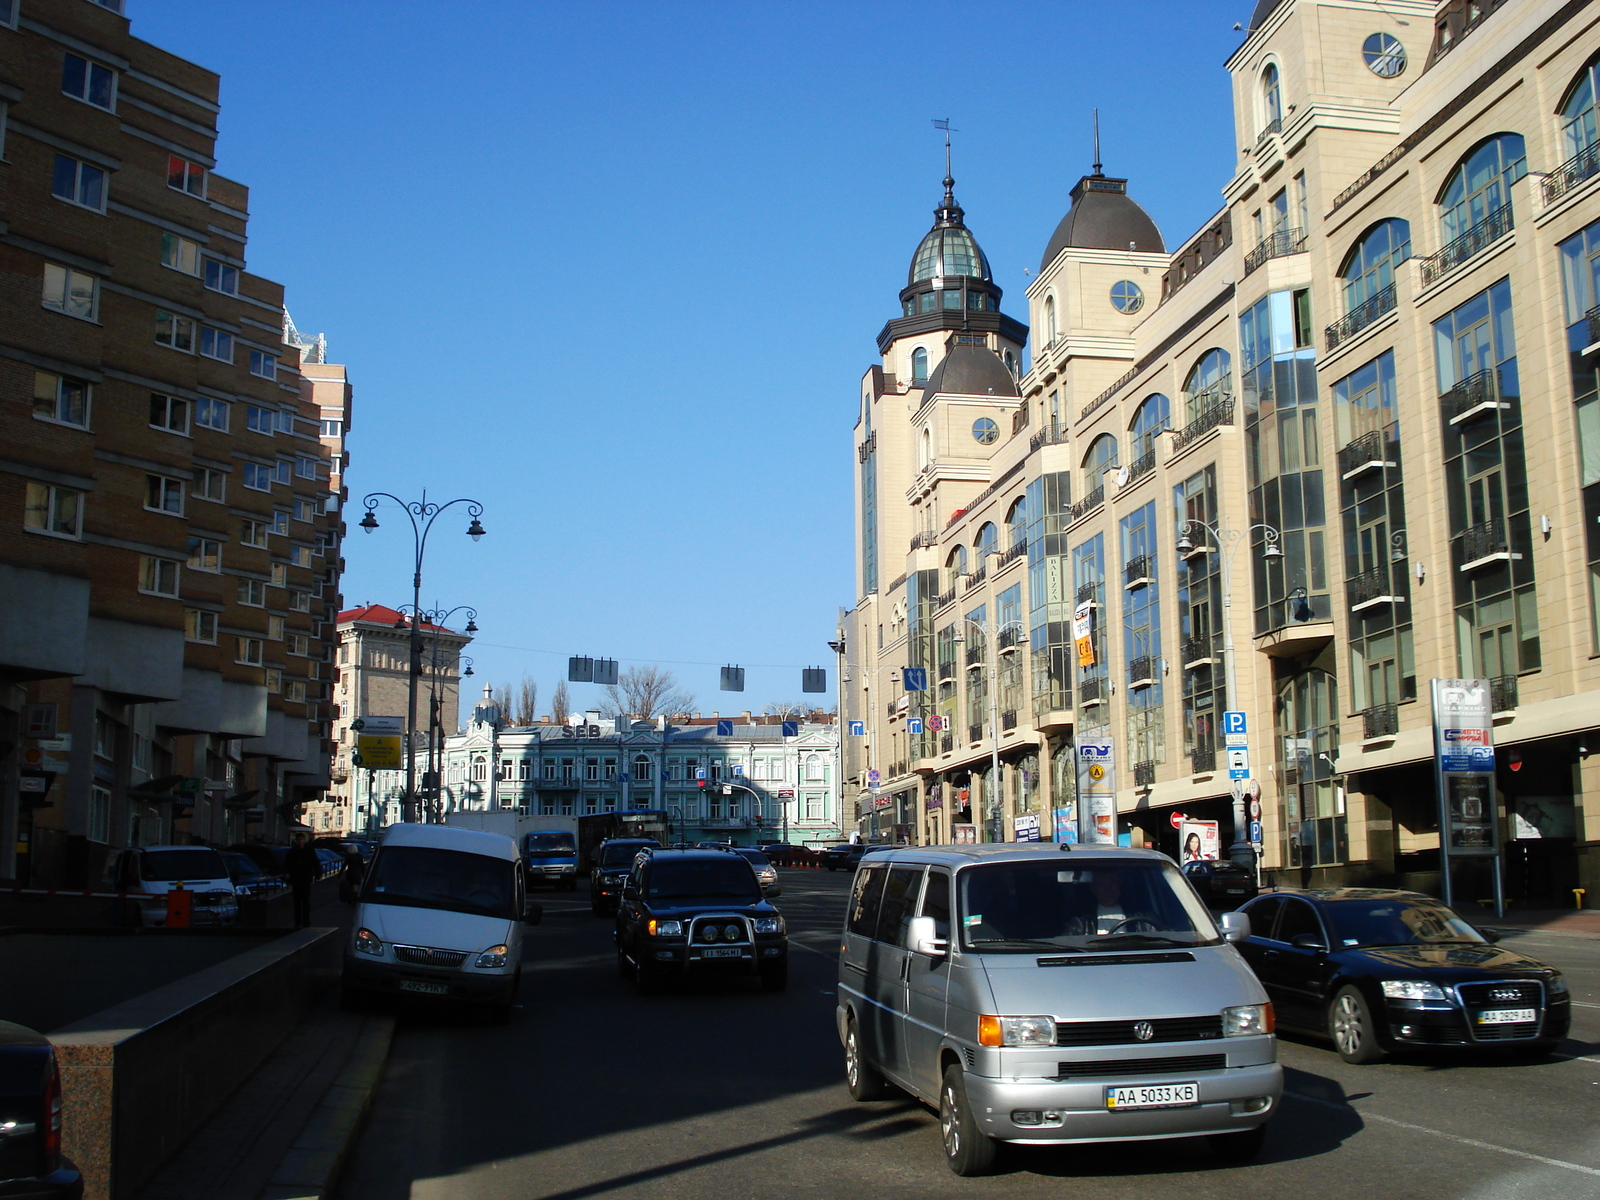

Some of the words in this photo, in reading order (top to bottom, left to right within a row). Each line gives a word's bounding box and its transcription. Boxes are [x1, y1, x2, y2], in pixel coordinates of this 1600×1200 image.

[1050, 558, 1059, 601] BALIZZA
[561, 724, 601, 738] SEB
[1230, 713, 1243, 732] P
[870, 796, 892, 807] PRSCHE
[1253, 823, 1260, 841] P
[1117, 1090, 1137, 1105] AA
[1141, 1087, 1172, 1103] 5033
[1174, 1086, 1194, 1101] KB
